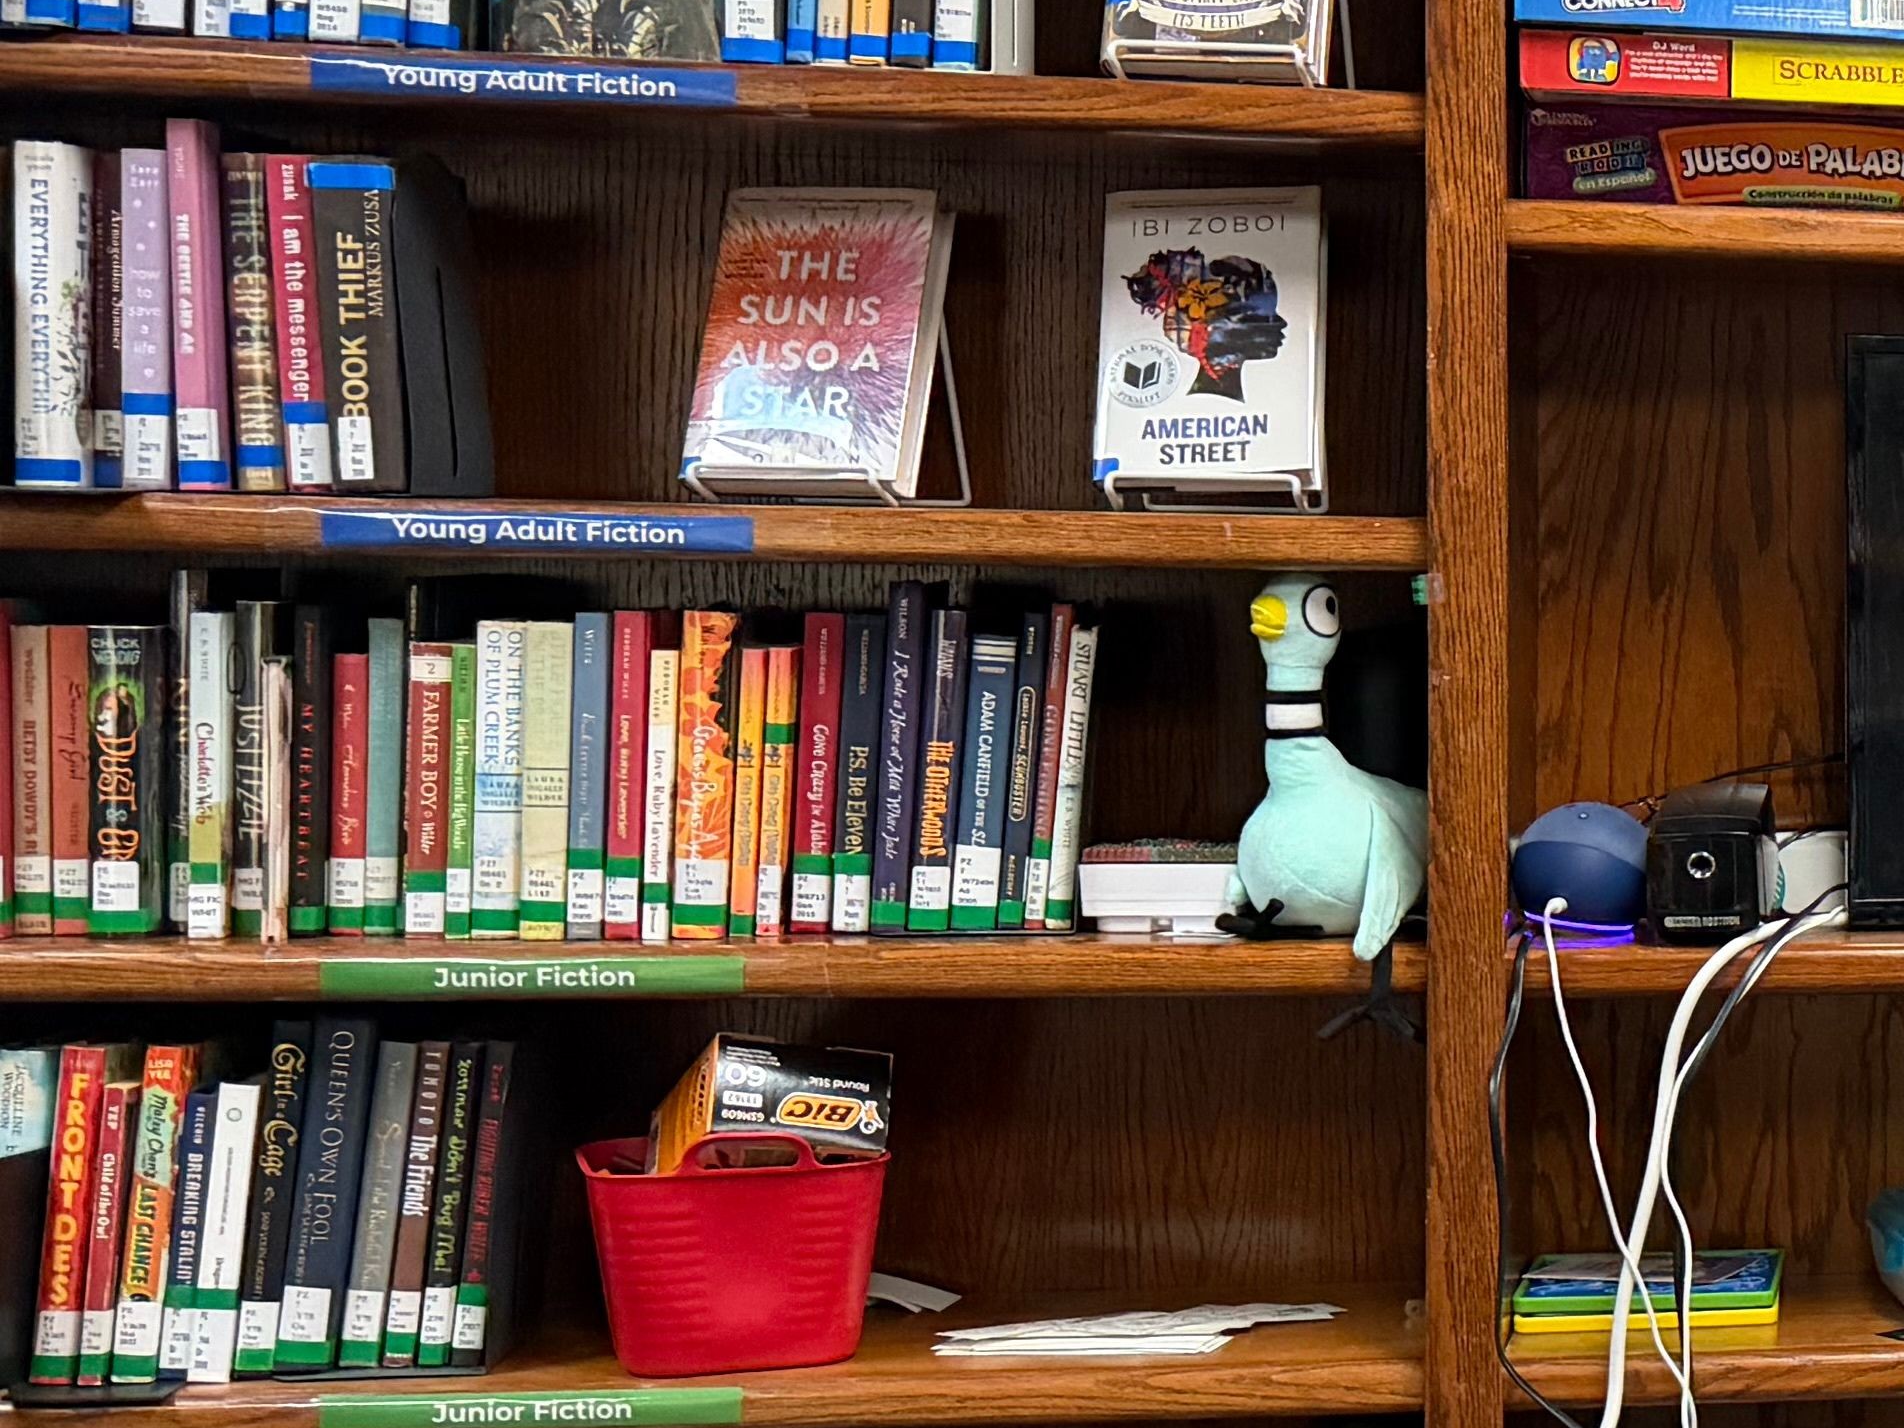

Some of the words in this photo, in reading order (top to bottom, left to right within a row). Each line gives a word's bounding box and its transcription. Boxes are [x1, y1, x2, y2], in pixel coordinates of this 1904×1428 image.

[383, 65, 477, 95] Young
[487, 70, 569, 93] Adult
[577, 75, 677, 98] Fiction
[1680, 143, 1772, 180] JUEGO
[1776, 149, 1802, 168] DE
[284, 228, 301, 254] am
[1132, 219, 1170, 237] IBI
[1187, 215, 1285, 236] ZOBOI
[30, 178, 50, 307] EVERYTHING
[284, 261, 304, 292] the
[336, 231, 366, 325] THIEF
[777, 250, 859, 281] THE
[737, 295, 828, 326] SUN
[844, 296, 882, 326] IS
[283, 299, 310, 403] messenger
[721, 340, 841, 371] ALSO
[850, 341, 880, 372] A
[339, 335, 369, 417] BOOK
[1142, 414, 1268, 440] AMERICAN
[1159, 440, 1251, 465] STREET
[393, 516, 487, 544] Young
[495, 520, 577, 543] Adult
[586, 521, 685, 544] Fiction
[420, 689, 439, 766] FARMER
[420, 770, 438, 809] BOY
[434, 967, 528, 989] Junior
[536, 966, 635, 988] Fiction
[324, 1030, 356, 1122] QUEEN'S
[780, 1097, 862, 1126] BIC
[323, 1127, 347, 1187] OWN
[311, 1191, 337, 1246] FOOL
[431, 1401, 525, 1424] Junior
[534, 1399, 632, 1420] Fiction
